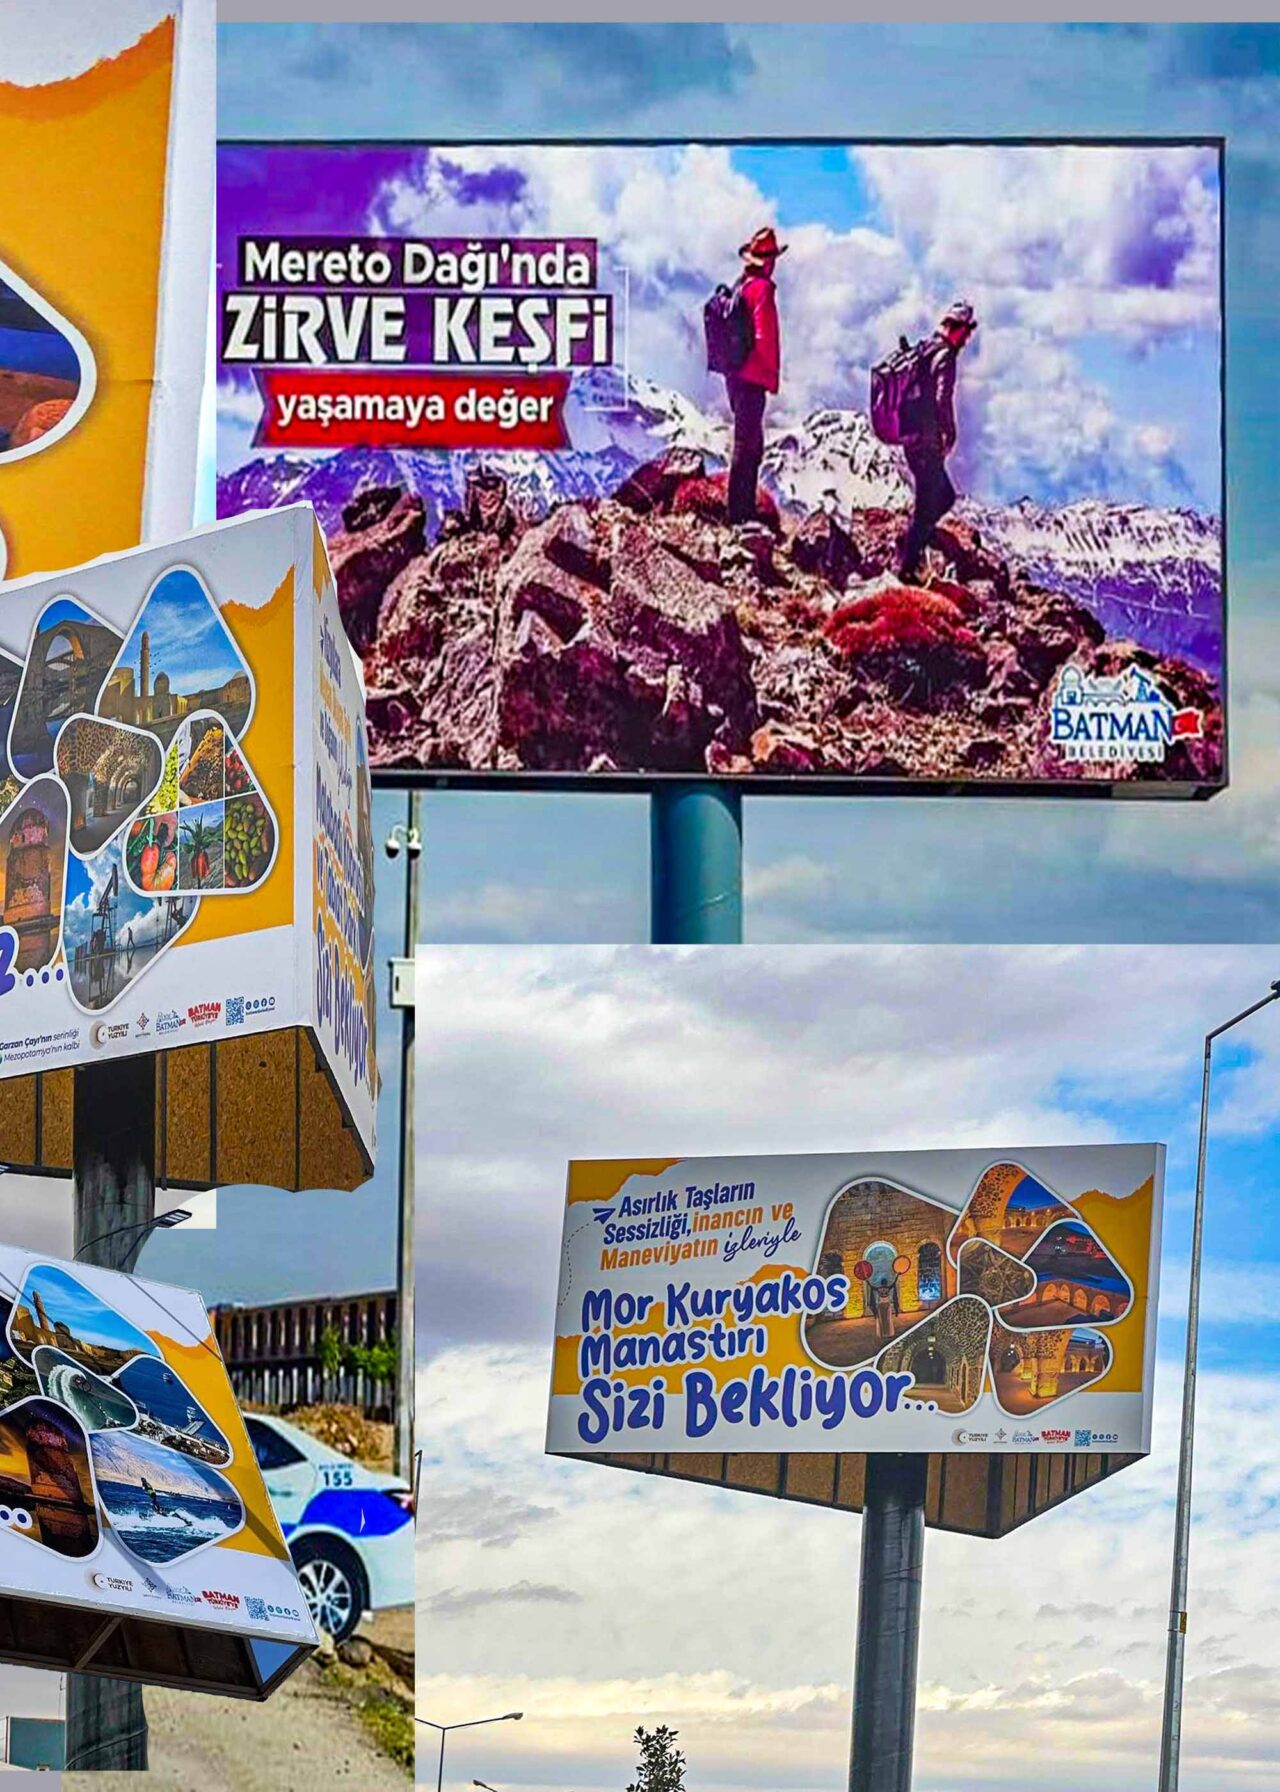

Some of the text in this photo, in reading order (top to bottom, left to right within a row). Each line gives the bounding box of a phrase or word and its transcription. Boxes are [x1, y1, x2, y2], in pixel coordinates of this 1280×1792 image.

[244, 241, 591, 291] Mereto Dağı'nda
[277, 388, 554, 428] yaşamaya değer
[1051, 708, 1174, 742] BATMAN
[187, 1001, 222, 1018] BATMAN
[618, 1181, 756, 1218] Asırlık Taşların
[771, 1201, 794, 1221] ve
[600, 1216, 803, 1271] Maneviyatın izleriyle
[581, 1274, 847, 1333] Mor Kuryakos
[581, 1322, 765, 1378] Manastırı
[578, 1367, 936, 1444] Sizi Bekliyor...
[323, 1471, 353, 1487] 155
[201, 1590, 241, 1604] BATMAN
